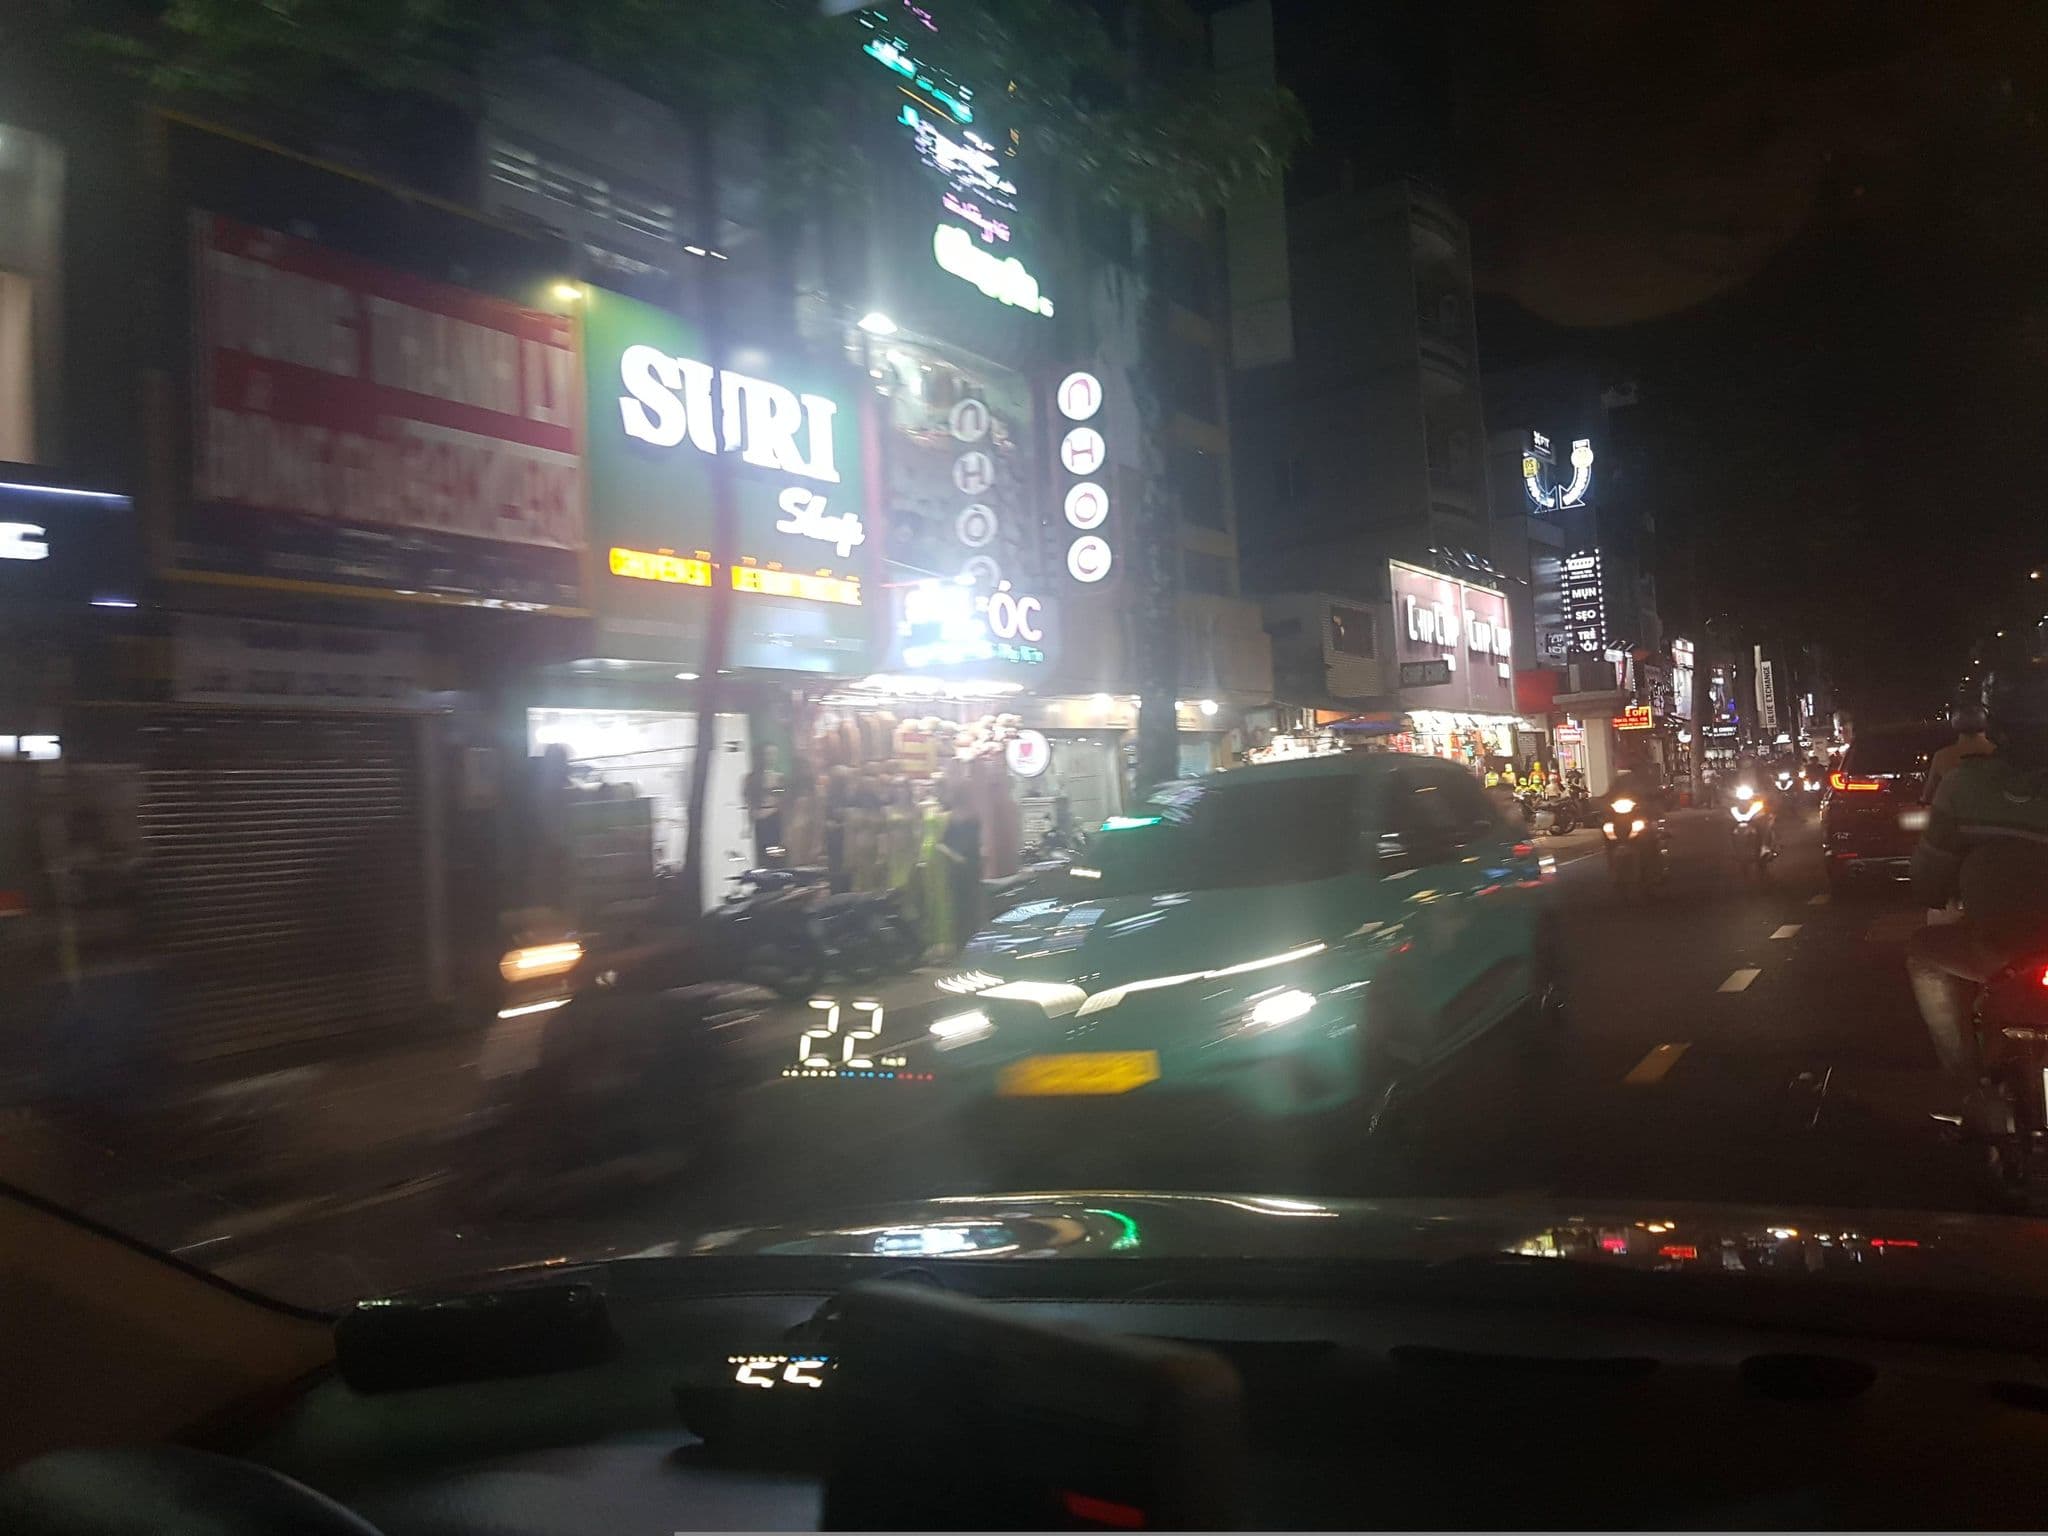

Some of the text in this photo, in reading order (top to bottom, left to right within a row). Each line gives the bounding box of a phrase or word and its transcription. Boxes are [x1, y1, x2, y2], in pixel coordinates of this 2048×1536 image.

[619, 344, 840, 483] SURI
[1571, 586, 1597, 600] MỤN
[1575, 609, 1596, 622] SẸO
[1766, 703, 1775, 724] BLUE
[799, 1000, 883, 1068] 22
